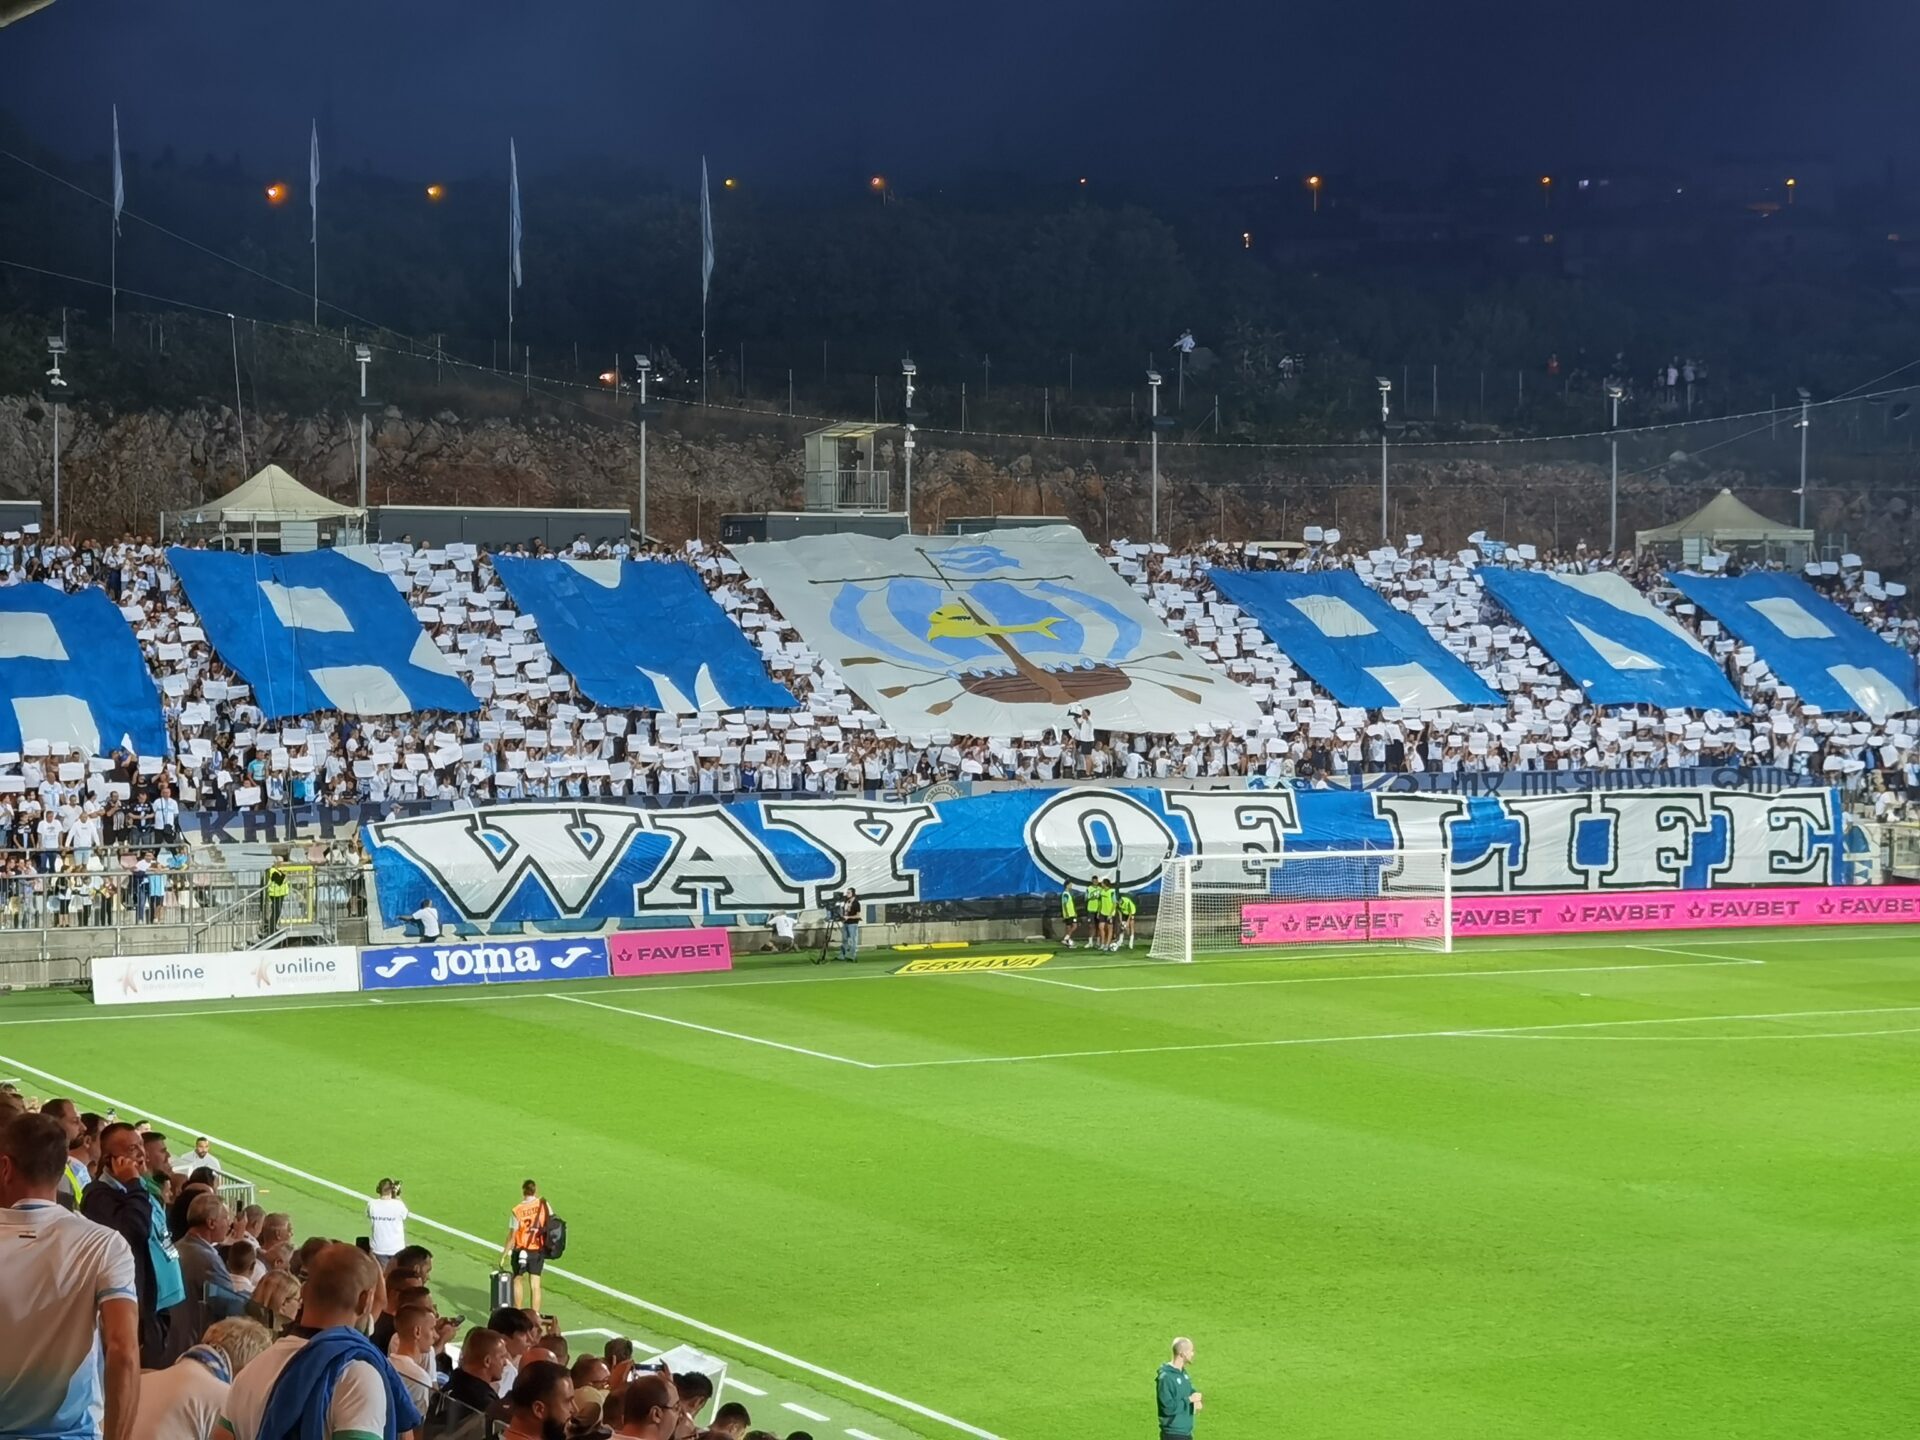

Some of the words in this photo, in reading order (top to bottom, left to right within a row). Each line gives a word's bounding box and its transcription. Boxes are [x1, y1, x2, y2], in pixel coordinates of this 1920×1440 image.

[368, 801, 938, 922] WAY
[1024, 787, 1305, 896] OF
[1376, 787, 1835, 893] LIFE
[1306, 912, 1404, 931] FAVBET
[1581, 904, 1675, 922] FAVBET
[1710, 900, 1801, 918] FAVBET
[637, 943, 725, 961] FAVBET
[142, 964, 205, 981] uniline
[275, 957, 336, 974] uniline
[906, 956, 1038, 973] GERMANIA
